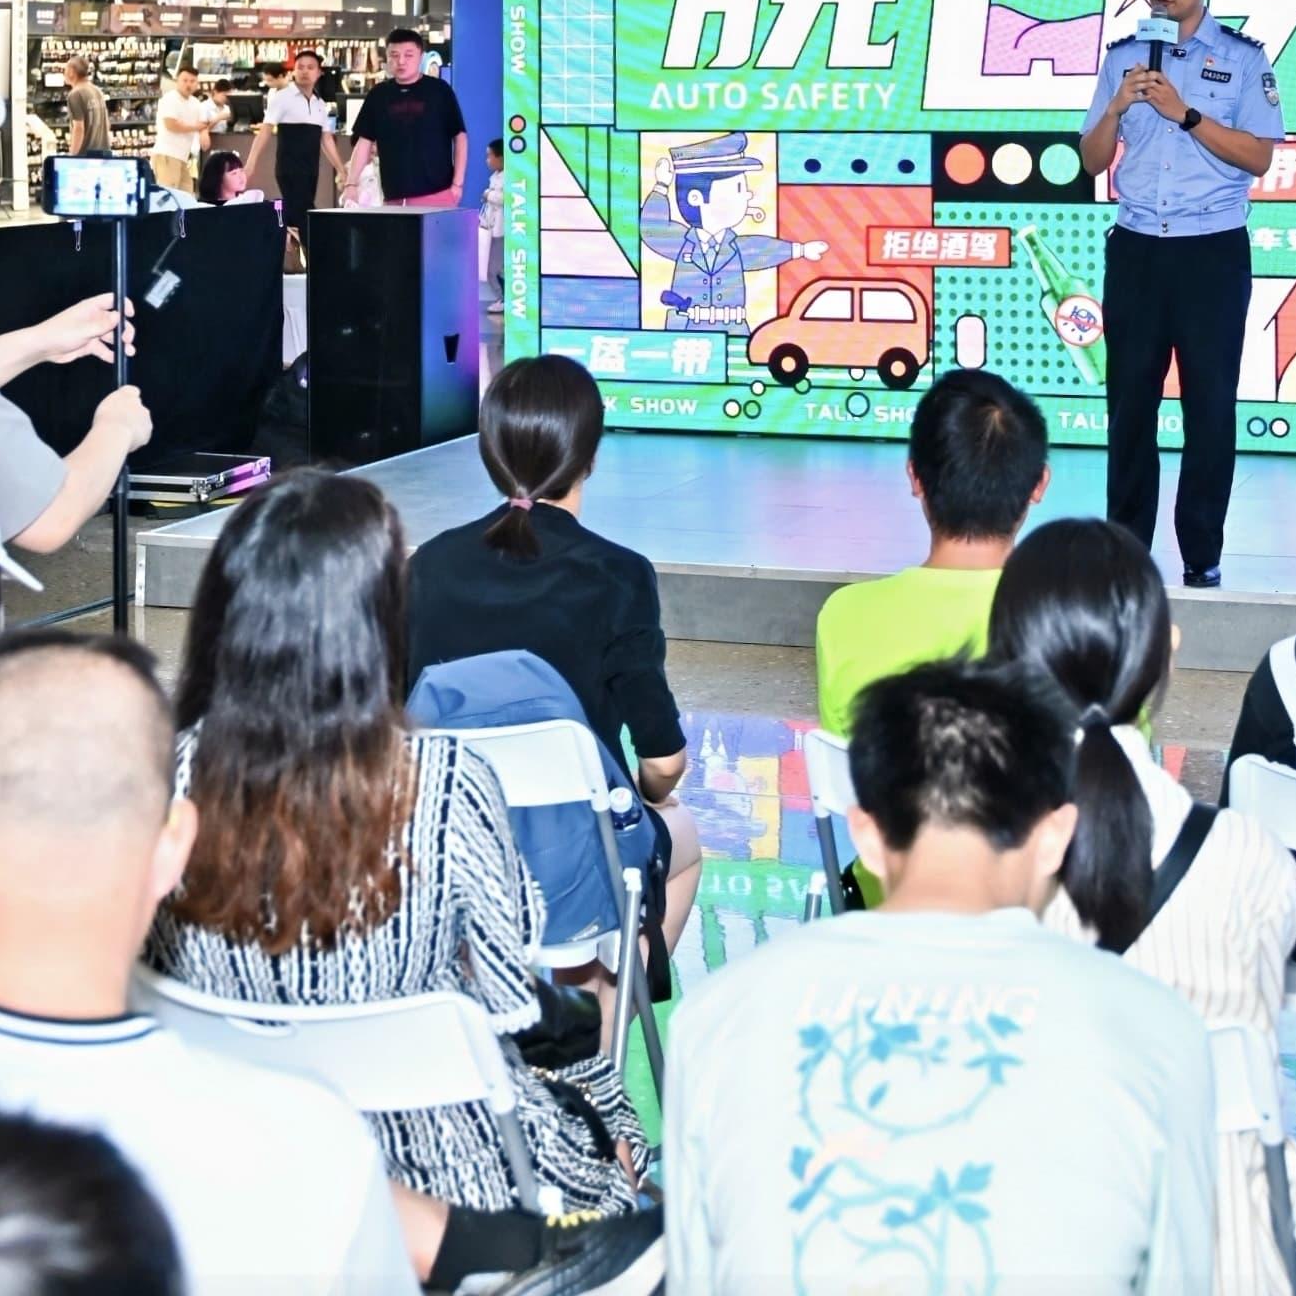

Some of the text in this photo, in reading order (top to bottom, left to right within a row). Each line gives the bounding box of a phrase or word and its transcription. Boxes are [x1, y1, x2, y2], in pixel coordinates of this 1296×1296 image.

[510, 5, 526, 76] SHOW
[650, 82, 897, 111] AUTO SAFETY
[511, 178, 527, 321] TALK SHOW
[881, 230, 998, 262] 拒绝酒驾
[549, 335, 713, 377] 一盔一带
[630, 397, 699, 416] SHOW
